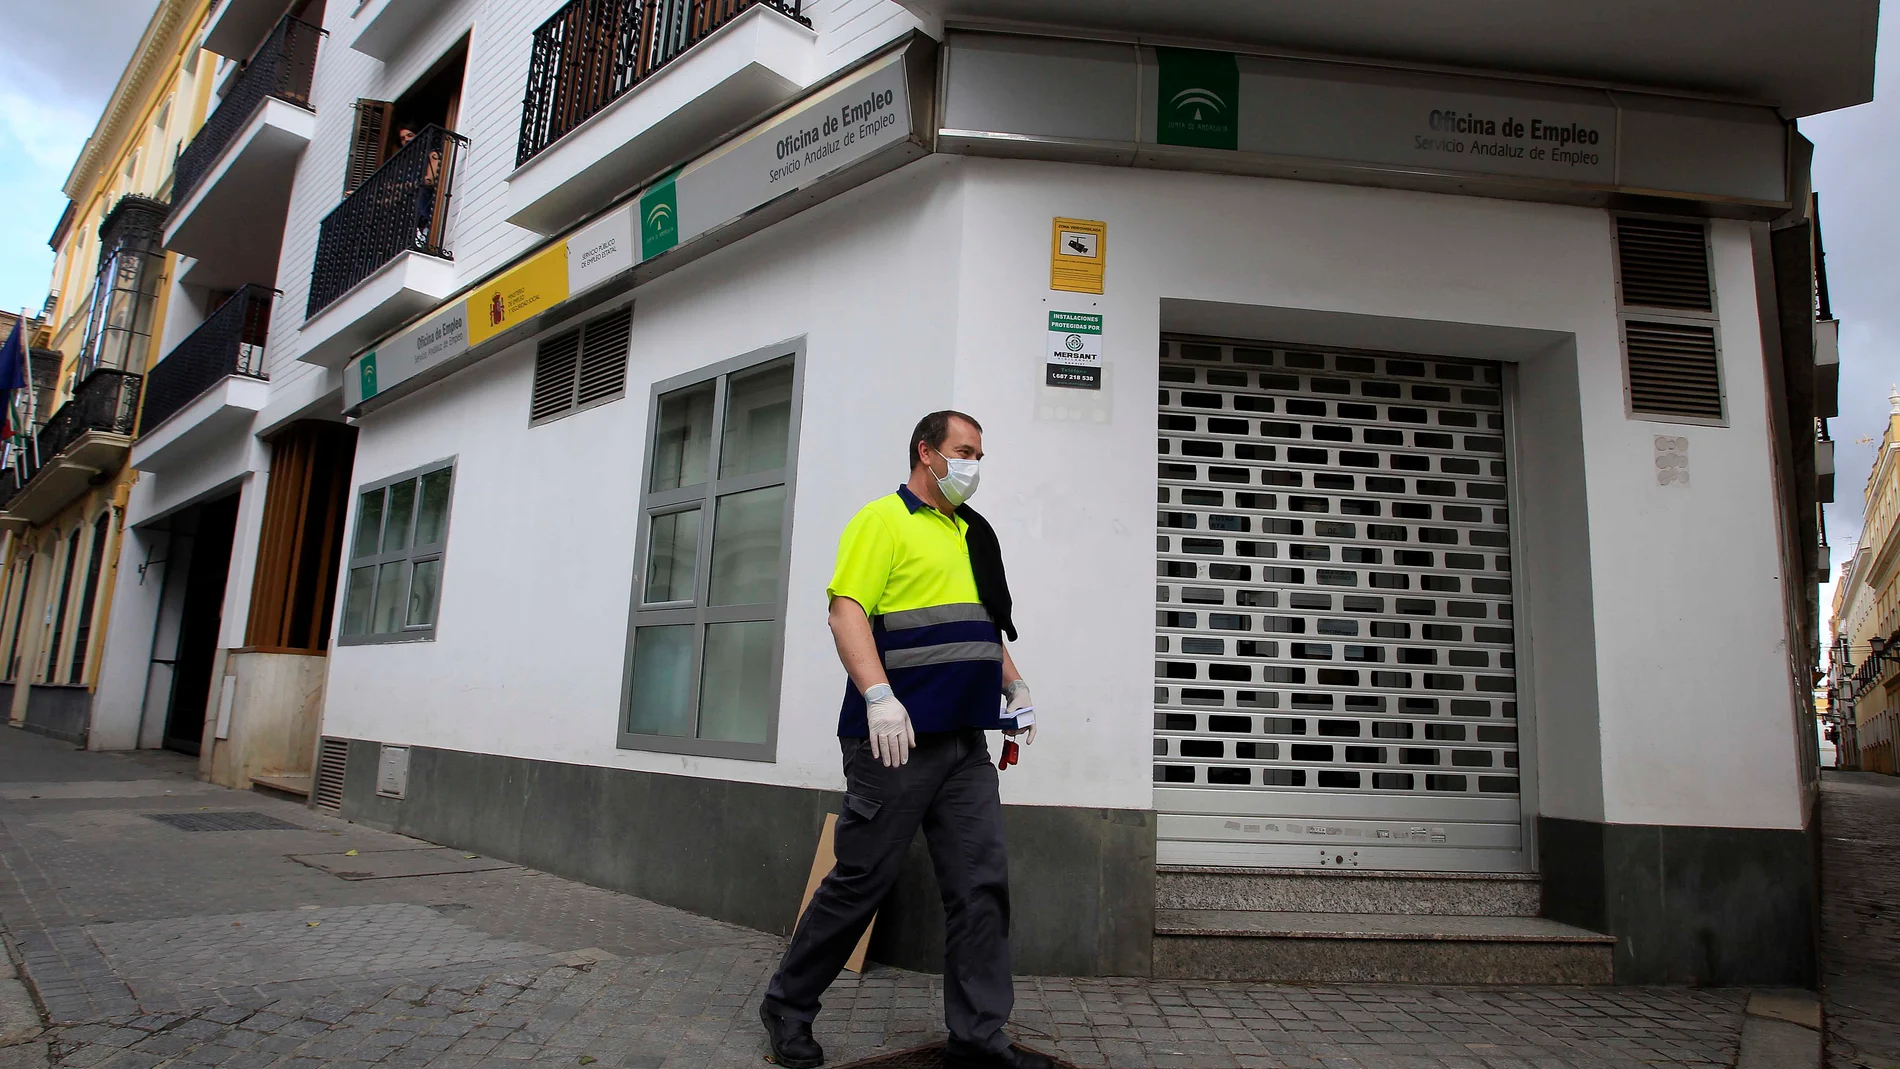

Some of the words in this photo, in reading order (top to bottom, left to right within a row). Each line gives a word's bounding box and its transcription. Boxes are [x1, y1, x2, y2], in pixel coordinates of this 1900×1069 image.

[776, 128, 819, 160] Oficina
[822, 116, 838, 136] de
[842, 89, 893, 127] Empleo
[1429, 109, 1495, 136] Oficina
[1502, 117, 1524, 138] de
[1531, 119, 1599, 147] Empleo
[770, 158, 800, 183] Servicio
[804, 138, 840, 166] Andaluz
[844, 132, 855, 147] de
[860, 113, 895, 139] Empleo
[1414, 135, 1464, 153] Servicio
[1470, 140, 1524, 158] Andaluz
[1530, 146, 1545, 160] de
[1552, 148, 1599, 166] Empleo
[582, 247, 598, 260] SERVICIO
[587, 253, 601, 266] EMPLEO
[1053, 313, 1099, 322] INSTALACIONES
[1051, 322, 1087, 330] PROTEGIDAS
[417, 333, 434, 350] Oficina
[435, 327, 441, 340] de
[443, 318, 462, 336] Empleo
[443, 340, 448, 348] de
[449, 333, 463, 346] Empleo
[1053, 351, 1097, 360] MERSANT
